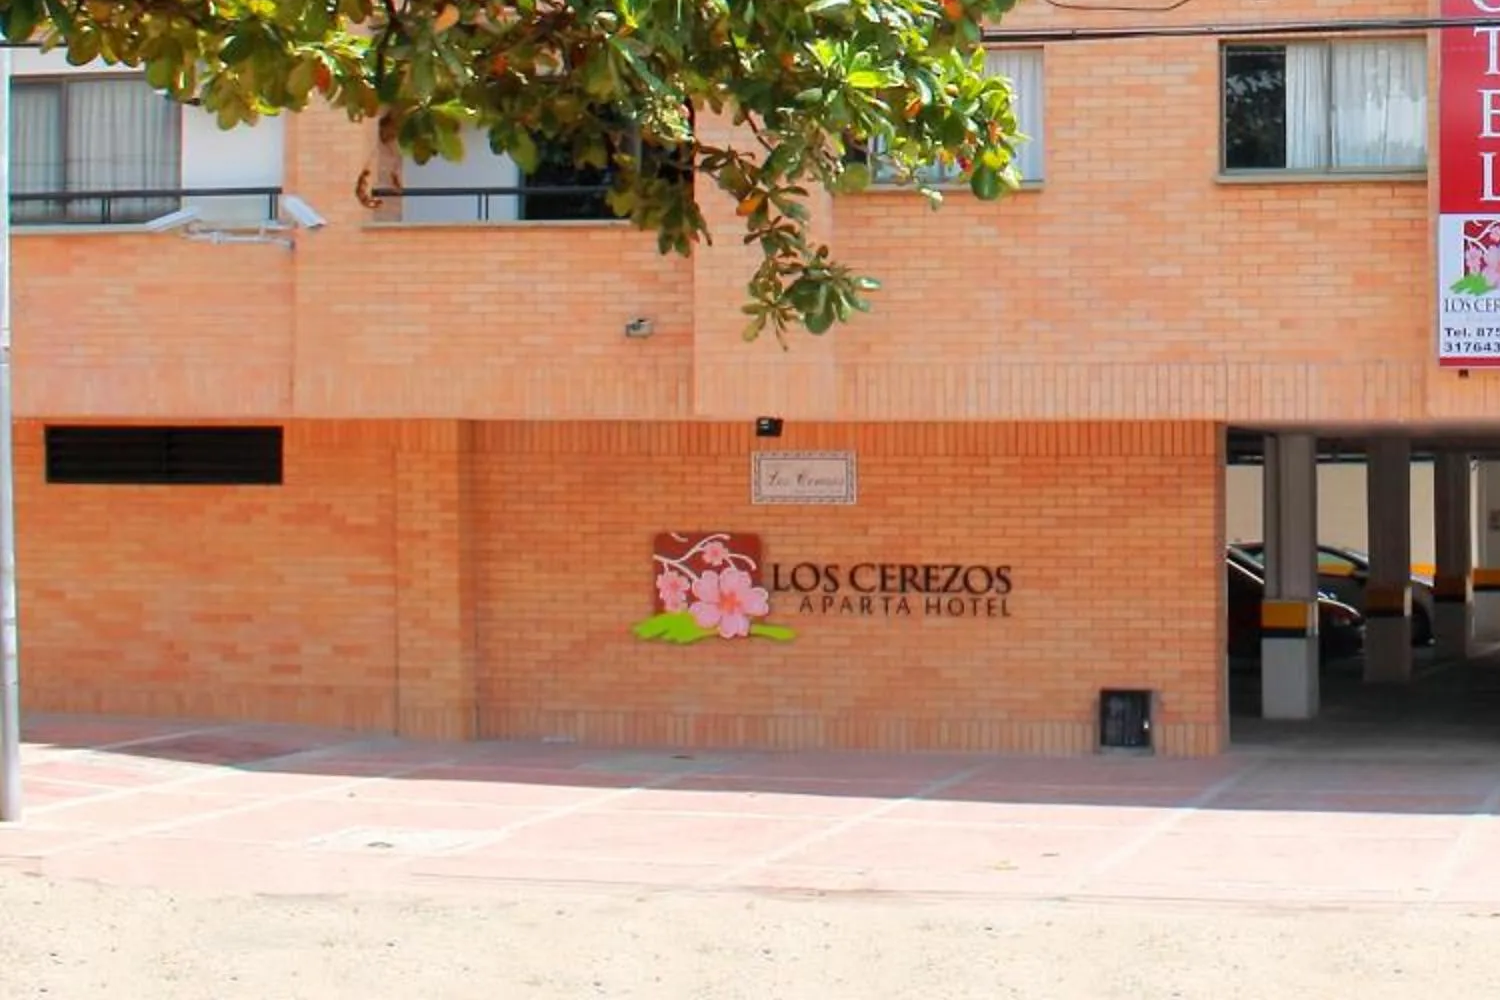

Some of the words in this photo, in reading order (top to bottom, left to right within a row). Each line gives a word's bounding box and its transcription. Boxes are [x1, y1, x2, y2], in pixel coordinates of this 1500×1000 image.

[1444, 297, 1471, 313] LOS
[1444, 327, 1471, 338] Tel.
[773, 562, 840, 594] LOS
[849, 562, 1012, 595] CEREZOS
[800, 595, 911, 617] APARTA
[925, 597, 1011, 617] HOTEL
